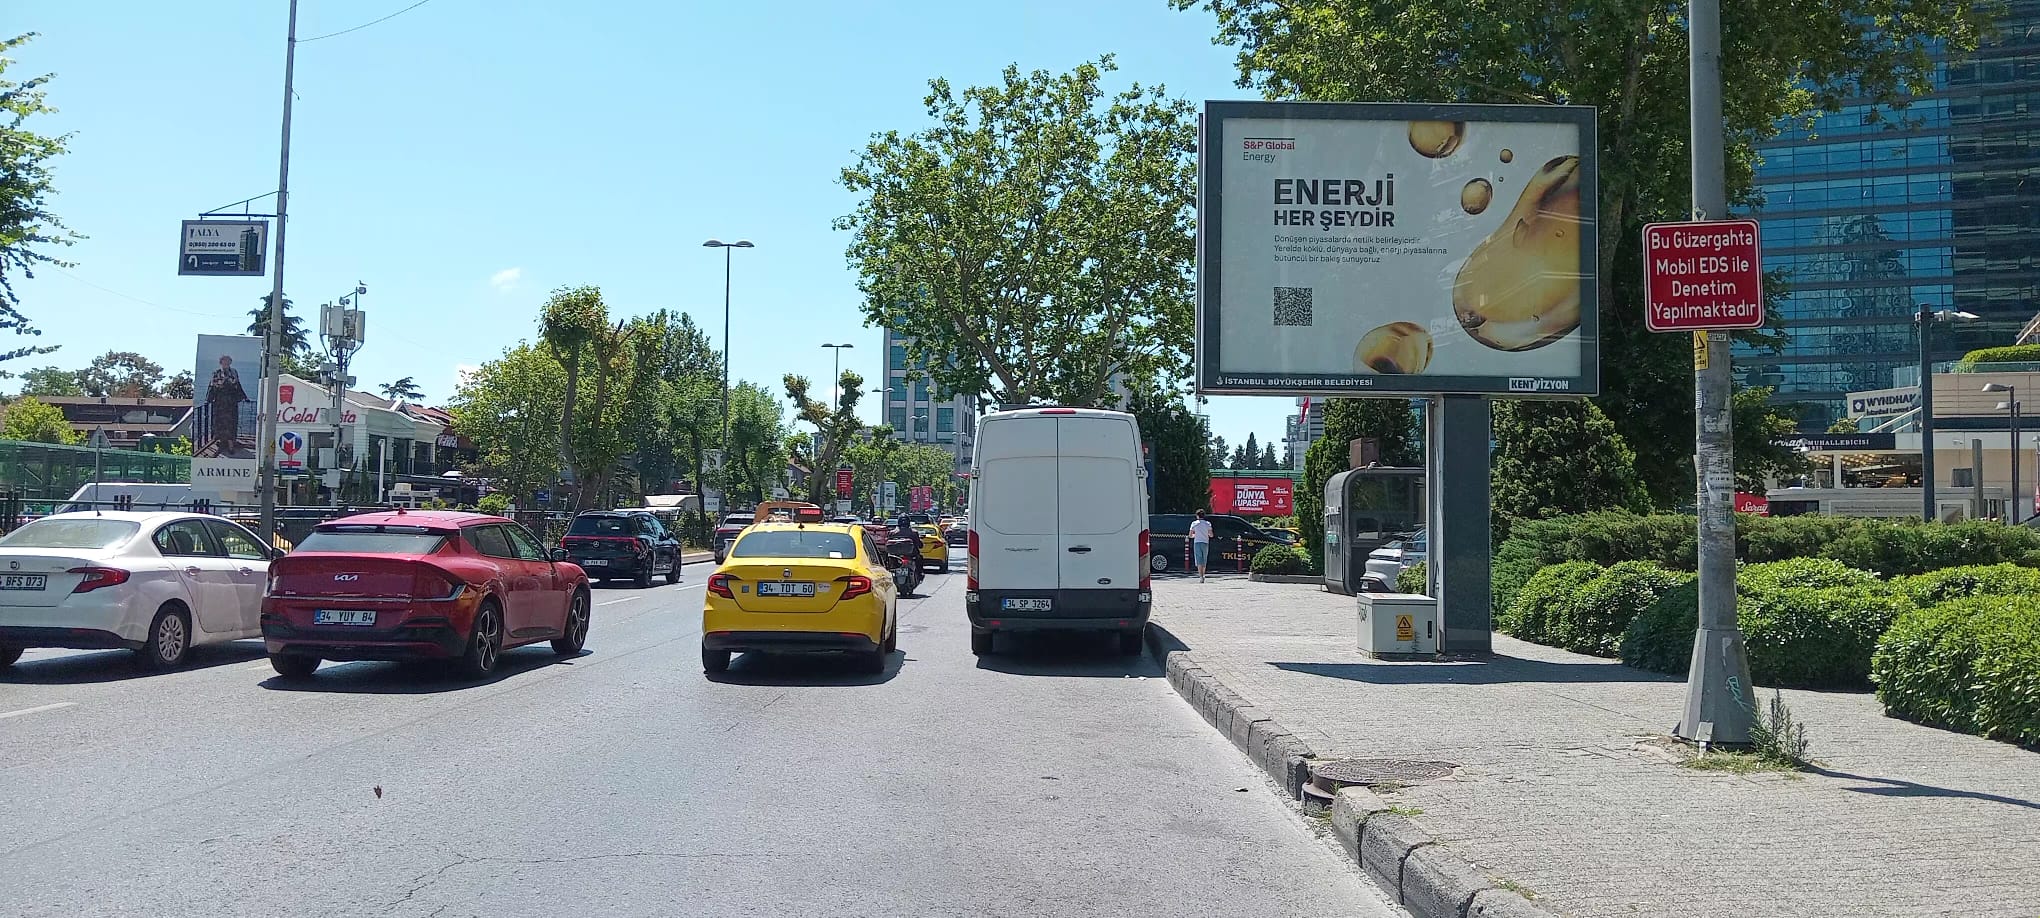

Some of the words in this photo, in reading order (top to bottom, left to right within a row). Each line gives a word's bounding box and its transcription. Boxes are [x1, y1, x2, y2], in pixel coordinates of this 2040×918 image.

[1243, 141, 1264, 150] S&P
[1265, 141, 1295, 150] Global
[1243, 152, 1276, 163] Energy
[1274, 173, 1394, 206] ENERJİ
[1274, 210, 1315, 226] HER
[1319, 207, 1395, 231] ŞEYDİR
[1651, 232, 1670, 249] Bu
[1673, 229, 1753, 251] Güzergahta
[1656, 258, 1695, 276] Mobil
[1699, 256, 1729, 274] EDS
[1732, 256, 1750, 272] ile
[1671, 280, 1737, 297] Denetim
[1652, 299, 1756, 324] Yapılmaktadır
[1224, 376, 1266, 386] İSTANBUL
[1267, 377, 1323, 387] BÜYÜKŞEHİR
[1324, 377, 1373, 386] BELEDİYESİ
[282, 406, 320, 424] Celal
[196, 467, 251, 478] ARMINE
[1236, 488, 1266, 500] DÜNYA
[1740, 501, 1769, 513] Saray
[6, 576, 23, 586] BFS
[26, 576, 43, 587] 073
[763, 583, 774, 593] 34
[802, 584, 813, 593] 60
[1007, 600, 1016, 608] 34
[1019, 600, 1029, 608] SP
[1032, 600, 1050, 609] 3264
[320, 611, 331, 621] 34
[338, 611, 356, 622] YUY
[361, 611, 373, 622] 84
